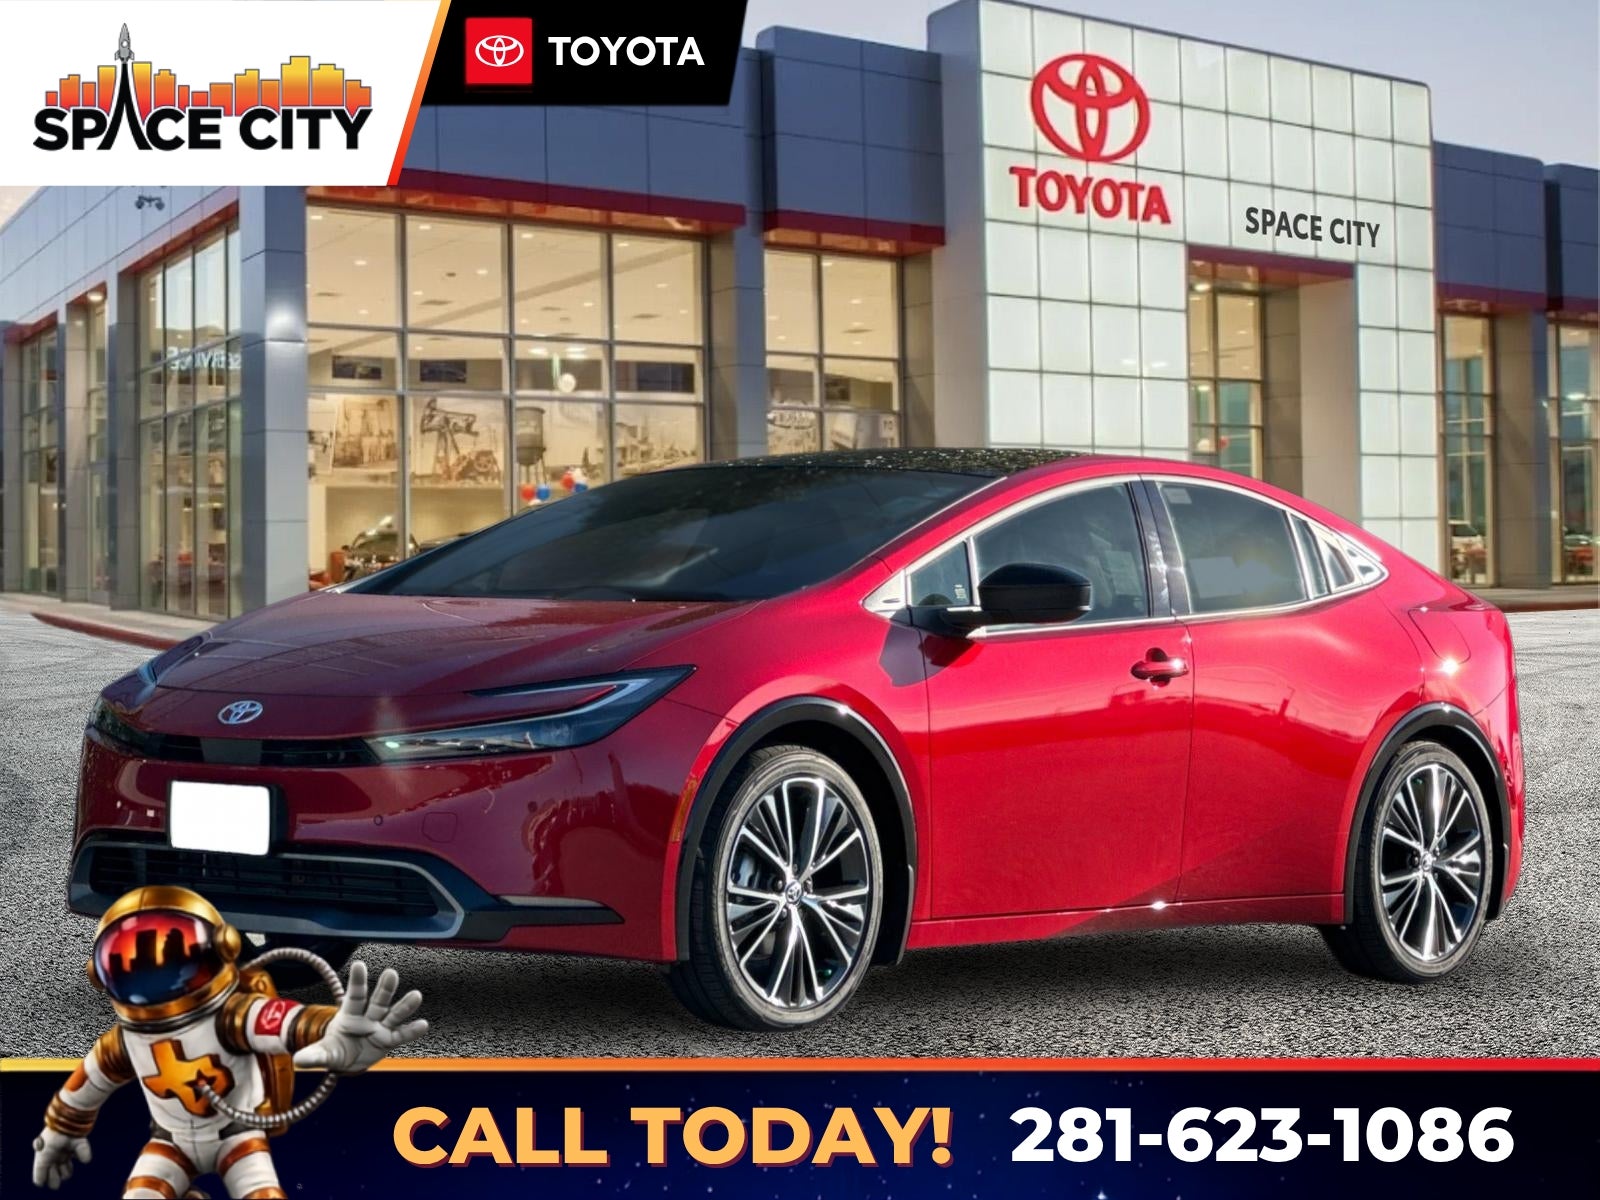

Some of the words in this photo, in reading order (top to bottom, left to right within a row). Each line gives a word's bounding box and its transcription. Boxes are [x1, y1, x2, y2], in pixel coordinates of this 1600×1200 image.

[1009, 167, 1171, 224] TOYOTA
[1245, 207, 1323, 241] SPACE
[1329, 217, 1381, 248] CITY
